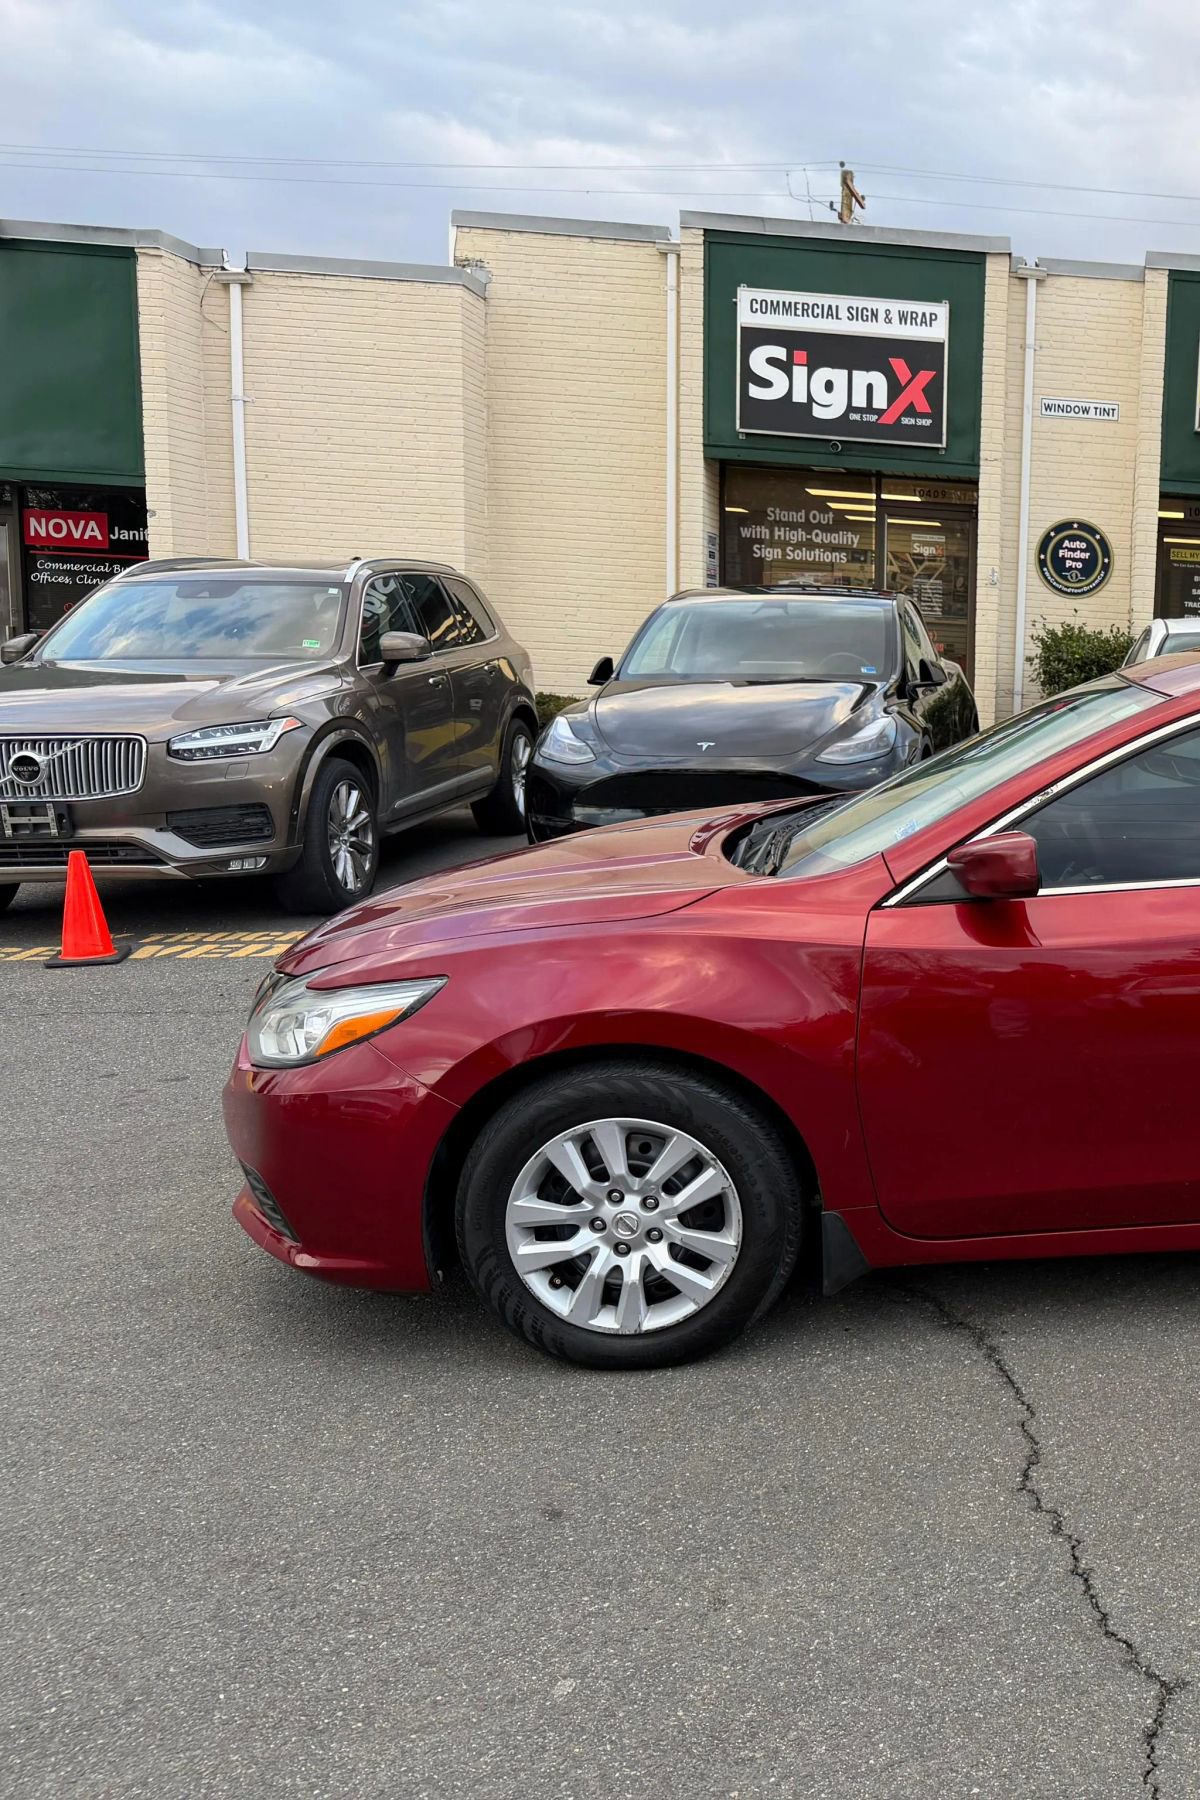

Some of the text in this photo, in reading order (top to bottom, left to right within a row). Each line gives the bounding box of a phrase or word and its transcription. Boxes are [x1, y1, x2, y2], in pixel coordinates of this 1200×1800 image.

[750, 298, 938, 327] COMMERCIAL SIGN & WRAP
[1043, 402, 1117, 418] WINDOW TINT
[849, 412, 879, 422] ONE STOP
[901, 417, 933, 427] SIGN SHOP
[767, 506, 834, 525] Stand Out
[30, 516, 103, 541] NOVA
[740, 525, 860, 548] with High-Quality
[1062, 539, 1087, 549] Auto
[753, 544, 848, 564] Sign Solutions
[1058, 549, 1091, 559] Finder
[1171, 551, 1189, 559] SELL
[1189, 552, 1200, 560] MY
[37, 560, 111, 573] Commercial
[1065, 560, 1083, 569] Pro
[31, 572, 73, 585] Offices,
